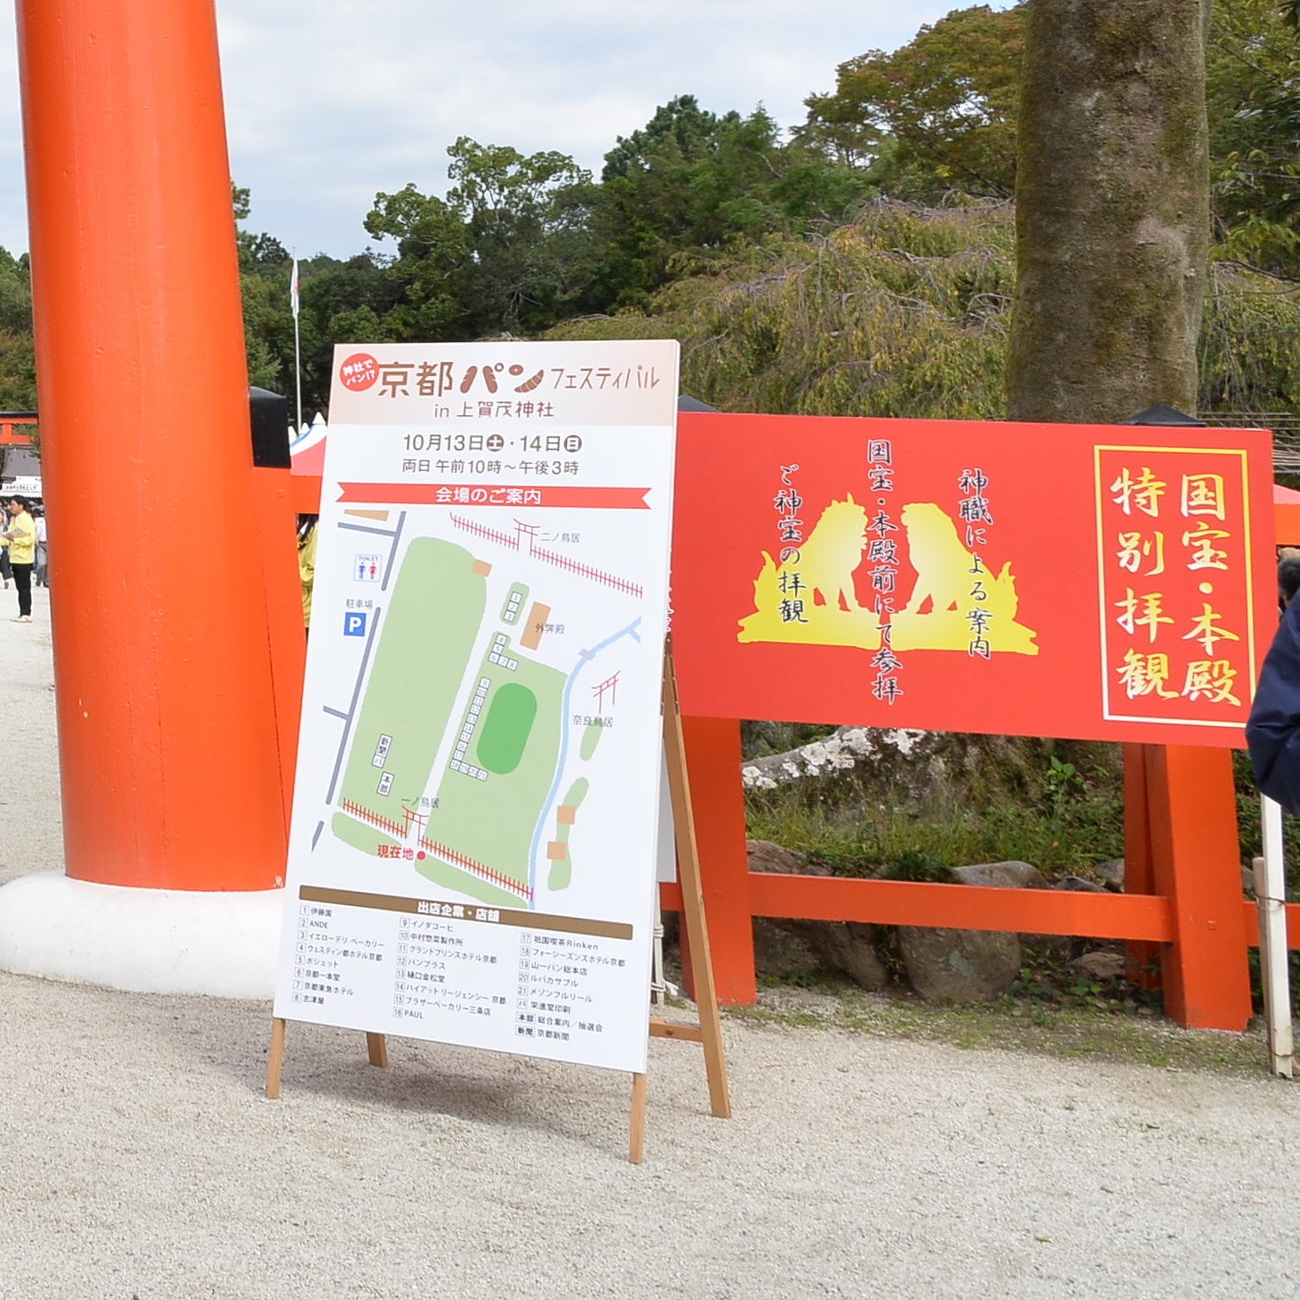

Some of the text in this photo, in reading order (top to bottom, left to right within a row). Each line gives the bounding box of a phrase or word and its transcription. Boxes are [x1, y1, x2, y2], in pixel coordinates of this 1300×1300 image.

[342, 358, 374, 377] 神社で
[434, 401, 554, 418] in 上賀茂神社
[402, 458, 431, 473] 両日
[435, 487, 542, 504] 会場のご案内
[773, 463, 809, 625] ご神宝の拝観
[867, 438, 903, 705] 国宝・本殿前にて参拝
[958, 468, 992, 660] 神職による案内
[1109, 466, 1179, 702] 特別拝観
[1179, 472, 1242, 707] 国宝・本殿
[348, 616, 362, 633] P
[573, 714, 613, 728] 奈良鳥居
[377, 844, 414, 860] 現在地
[418, 901, 500, 923] 出店企業・店舗
[309, 920, 328, 929] ANDE
[492, 996, 507, 1005] 京都
[404, 1010, 424, 1020] PAUL
[537, 1028, 570, 1041] 京都新聞
